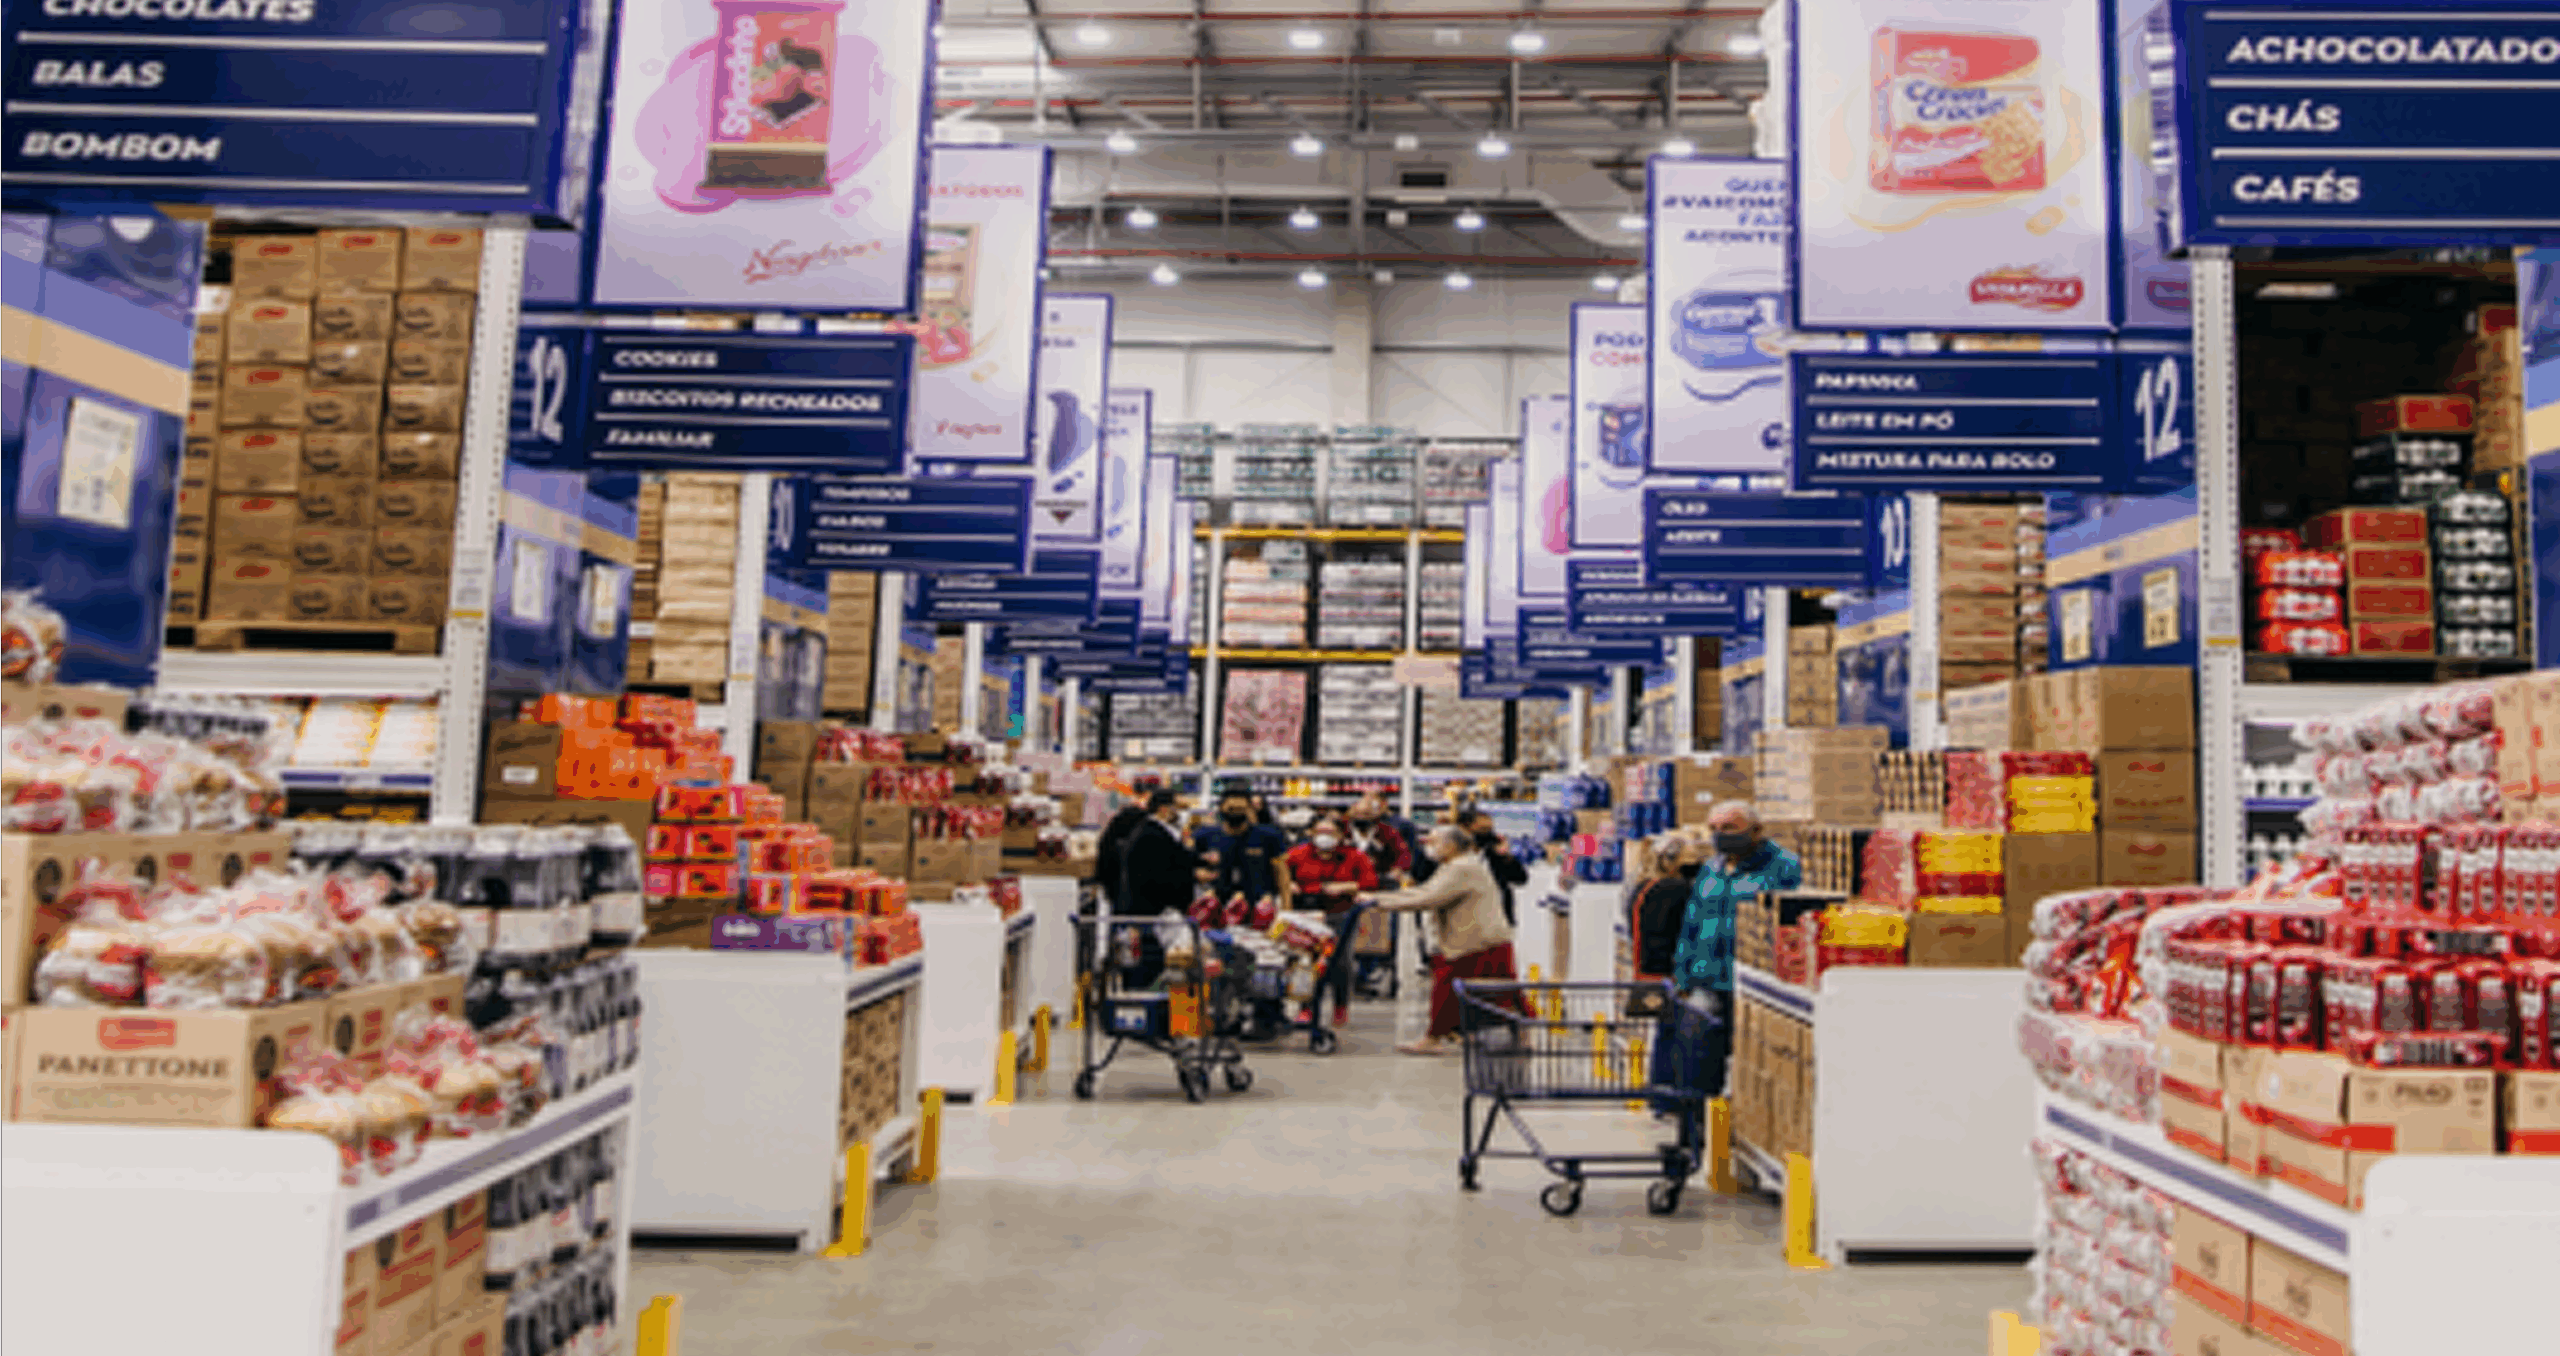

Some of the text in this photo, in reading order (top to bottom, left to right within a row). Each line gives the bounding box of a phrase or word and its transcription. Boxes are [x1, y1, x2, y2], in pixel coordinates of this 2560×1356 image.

[42, 0, 314, 21] CHOCOLATES
[2226, 36, 2560, 64] ACHOCOLATADO
[31, 58, 165, 88] BALAS
[2226, 99, 2341, 132] CHÁS
[20, 130, 223, 161] BOMBOM
[2232, 168, 2361, 203] CAFÉS
[613, 349, 719, 369] COOKIES
[530, 332, 567, 443] 12
[608, 388, 883, 412] BISCOITOS RECHEADOS
[1815, 407, 1955, 431] LEITE EM PÓ
[2134, 356, 2182, 462] 12
[604, 429, 717, 449] FAMILIAR
[1815, 450, 2056, 471] MISTURA PARA BOLO
[37, 1053, 230, 1079] PANETTONE
